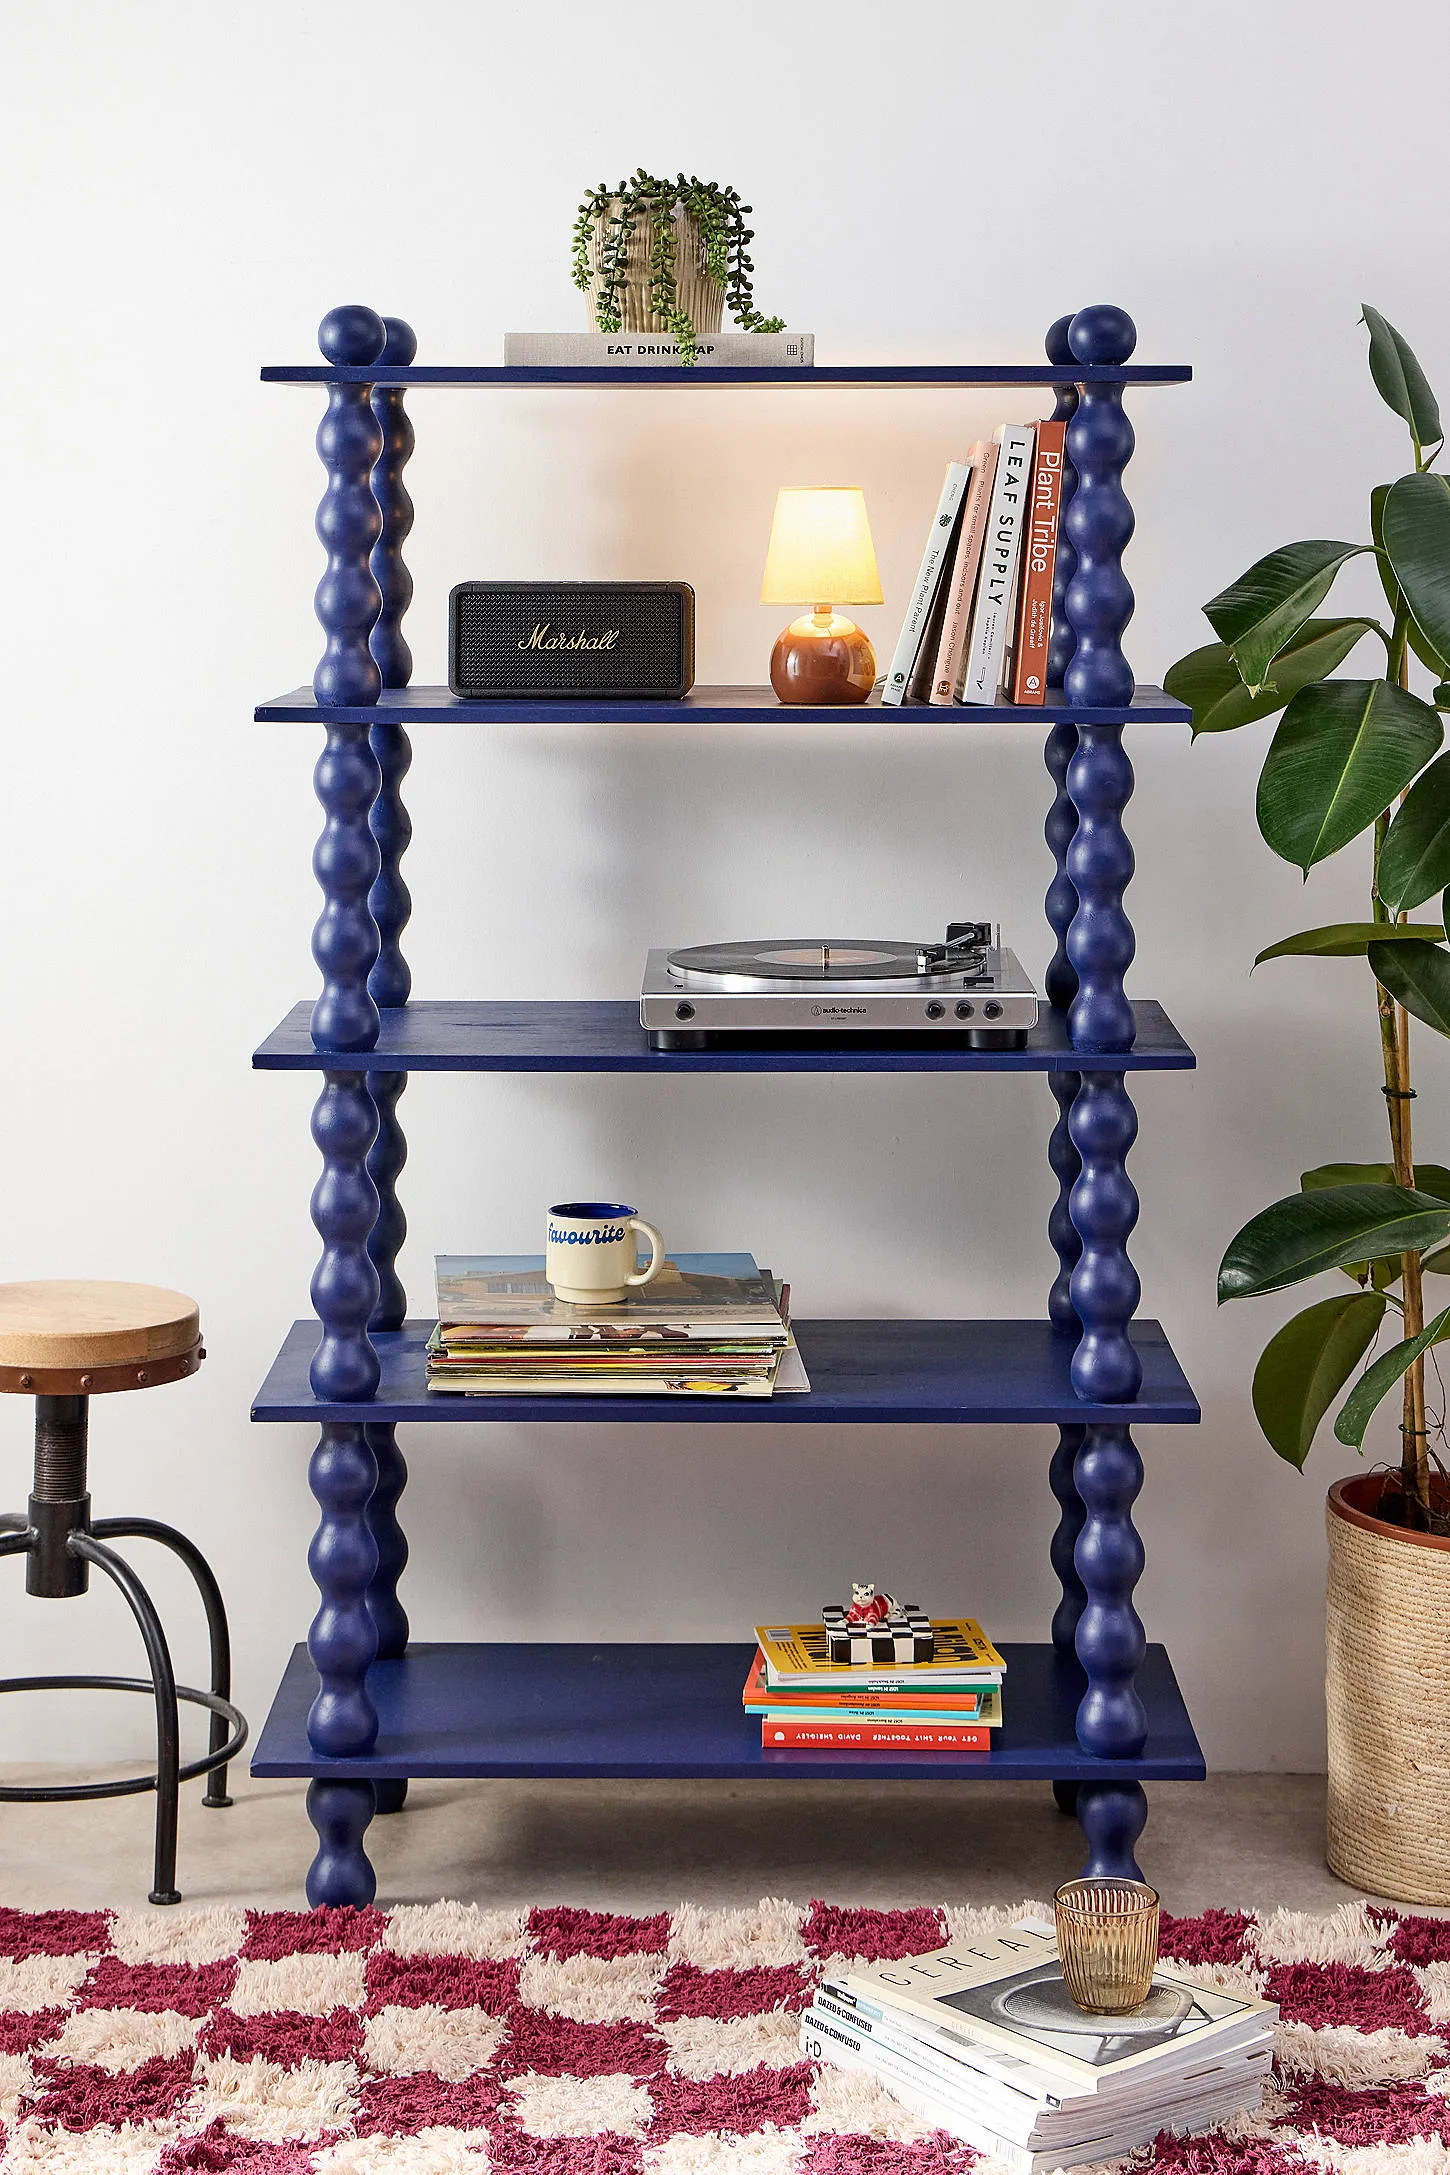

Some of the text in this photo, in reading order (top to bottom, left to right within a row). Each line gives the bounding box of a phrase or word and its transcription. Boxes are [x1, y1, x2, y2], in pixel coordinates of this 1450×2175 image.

[607, 345, 633, 355] EAT
[638, 345, 682, 355] DRINK
[980, 452, 990, 473] Green
[975, 480, 985, 502] Plants
[988, 440, 1026, 605] LEAF SUPPLY
[1031, 451, 1060, 572] Plant Tribe
[969, 513, 978, 534] small
[908, 550, 940, 633] The New Plant Parent
[956, 589, 964, 601] and
[954, 603, 962, 614] out
[517, 623, 621, 650] Marshall
[950, 621, 959, 641] Jason
[548, 1221, 626, 1246] favourite
[795, 1732, 978, 1743] GET YOUR SHIT TOGETHER DAVID SHRIGLEY
[878, 1929, 1057, 1987] CEREAL
[817, 1996, 837, 2013] DAZED
[836, 2006, 842, 2016] &
[841, 2009, 872, 2033] CONFUSED
[804, 2014, 861, 2052] DAZED & CONFUSED
